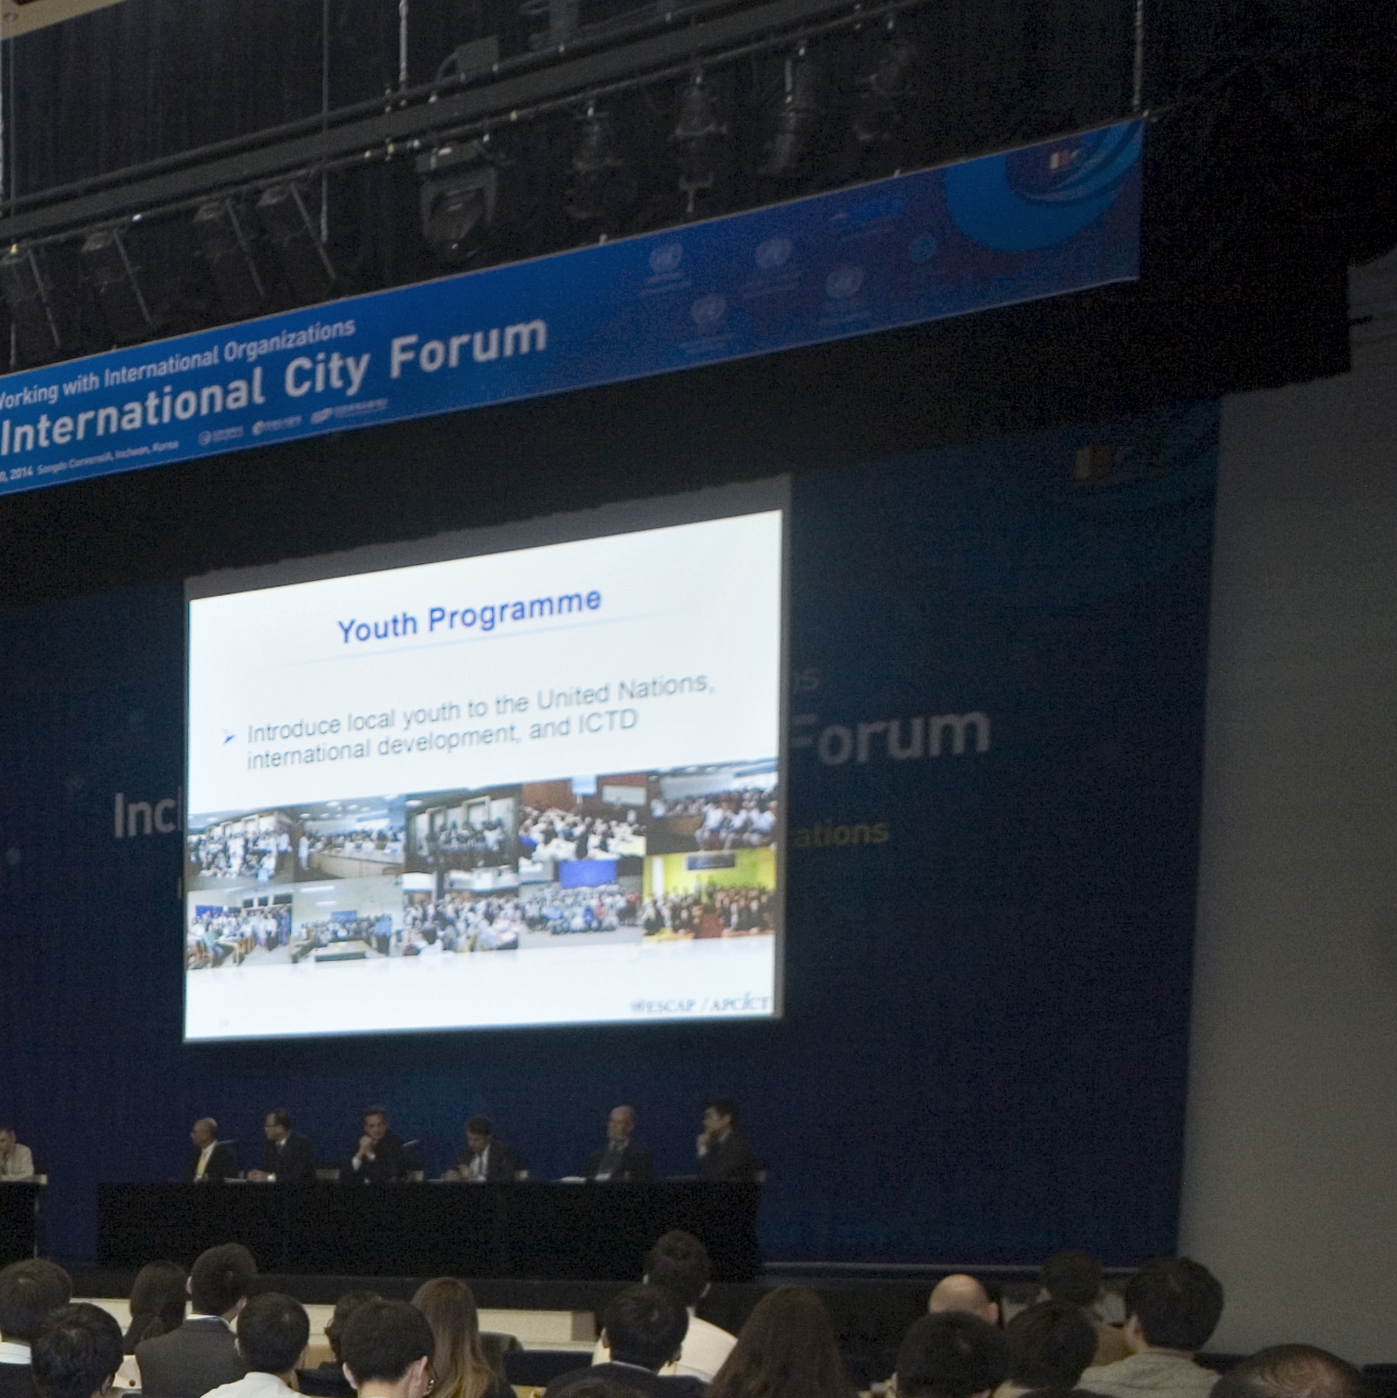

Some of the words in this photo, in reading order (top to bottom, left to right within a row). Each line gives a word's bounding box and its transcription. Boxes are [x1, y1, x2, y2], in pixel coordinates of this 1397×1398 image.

[0, 366, 265, 456] International
[285, 351, 371, 397] City
[389, 318, 549, 379] Forum
[62, 375, 100, 398] with
[104, 346, 219, 388] International
[223, 319, 356, 363] Organizations
[10, 464, 34, 480] 2014
[337, 612, 417, 643] Youth
[429, 590, 603, 632] Programme
[247, 738, 371, 769] international
[377, 721, 522, 755] development,
[529, 715, 571, 740] and
[578, 707, 639, 735] ICTD
[248, 718, 341, 744] Introduce
[348, 708, 396, 732] local
[403, 701, 461, 730] youth
[468, 699, 488, 718] to
[496, 694, 529, 715] the
[537, 682, 610, 711] United
[617, 673, 716, 701] Nations,
[114, 786, 182, 838] Inc
